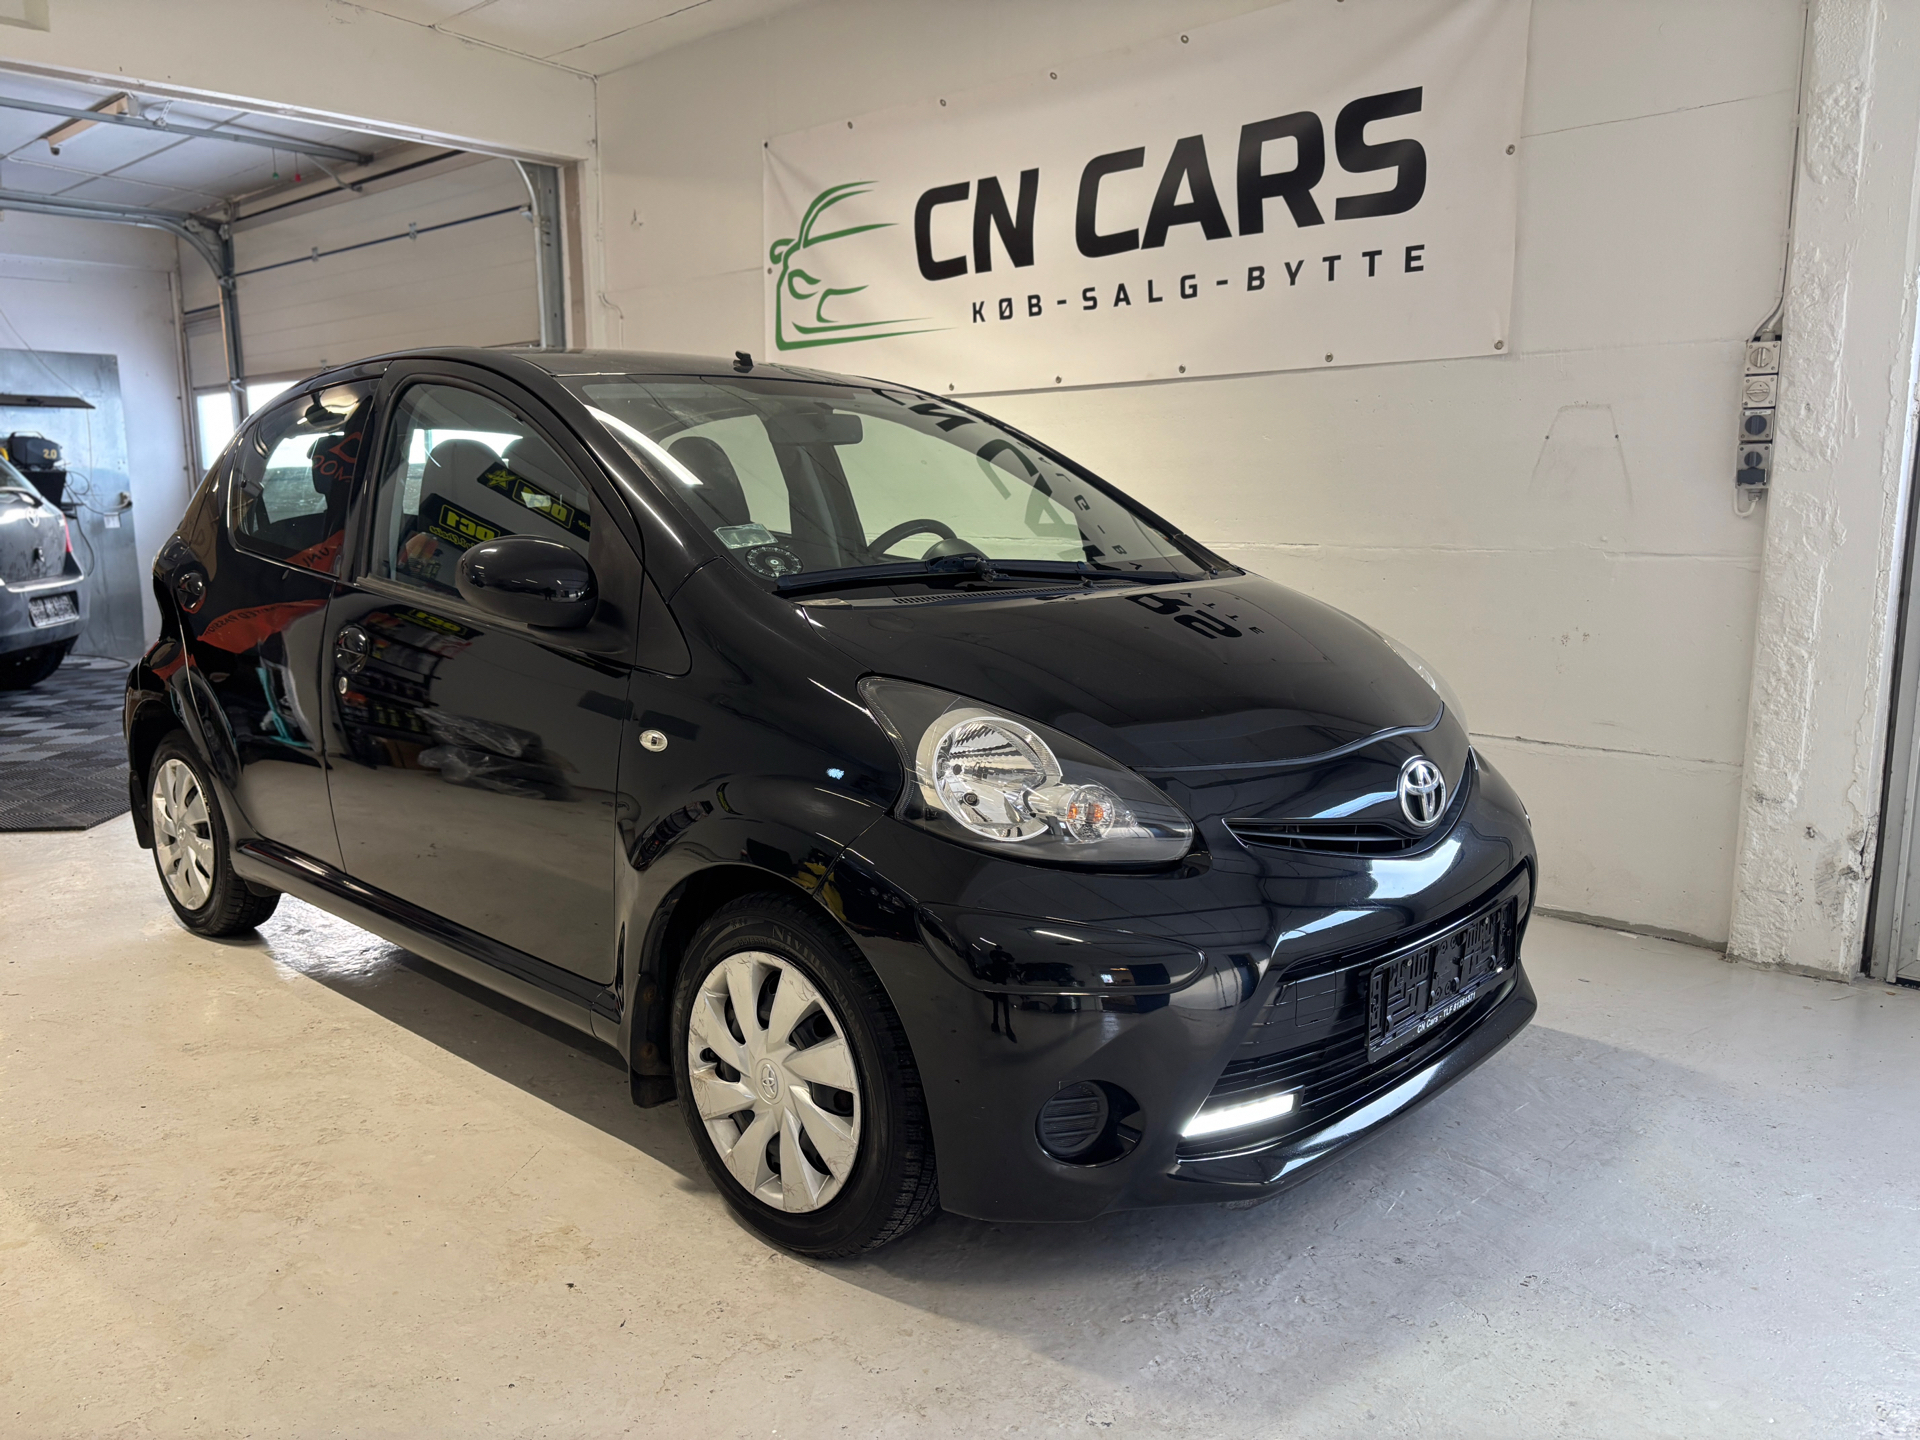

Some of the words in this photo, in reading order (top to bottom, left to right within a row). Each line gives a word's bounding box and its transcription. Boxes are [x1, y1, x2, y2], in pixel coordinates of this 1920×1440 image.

[914, 167, 1040, 281] CN
[1075, 86, 1427, 258] CARS
[771, 924, 830, 978] Nivius
